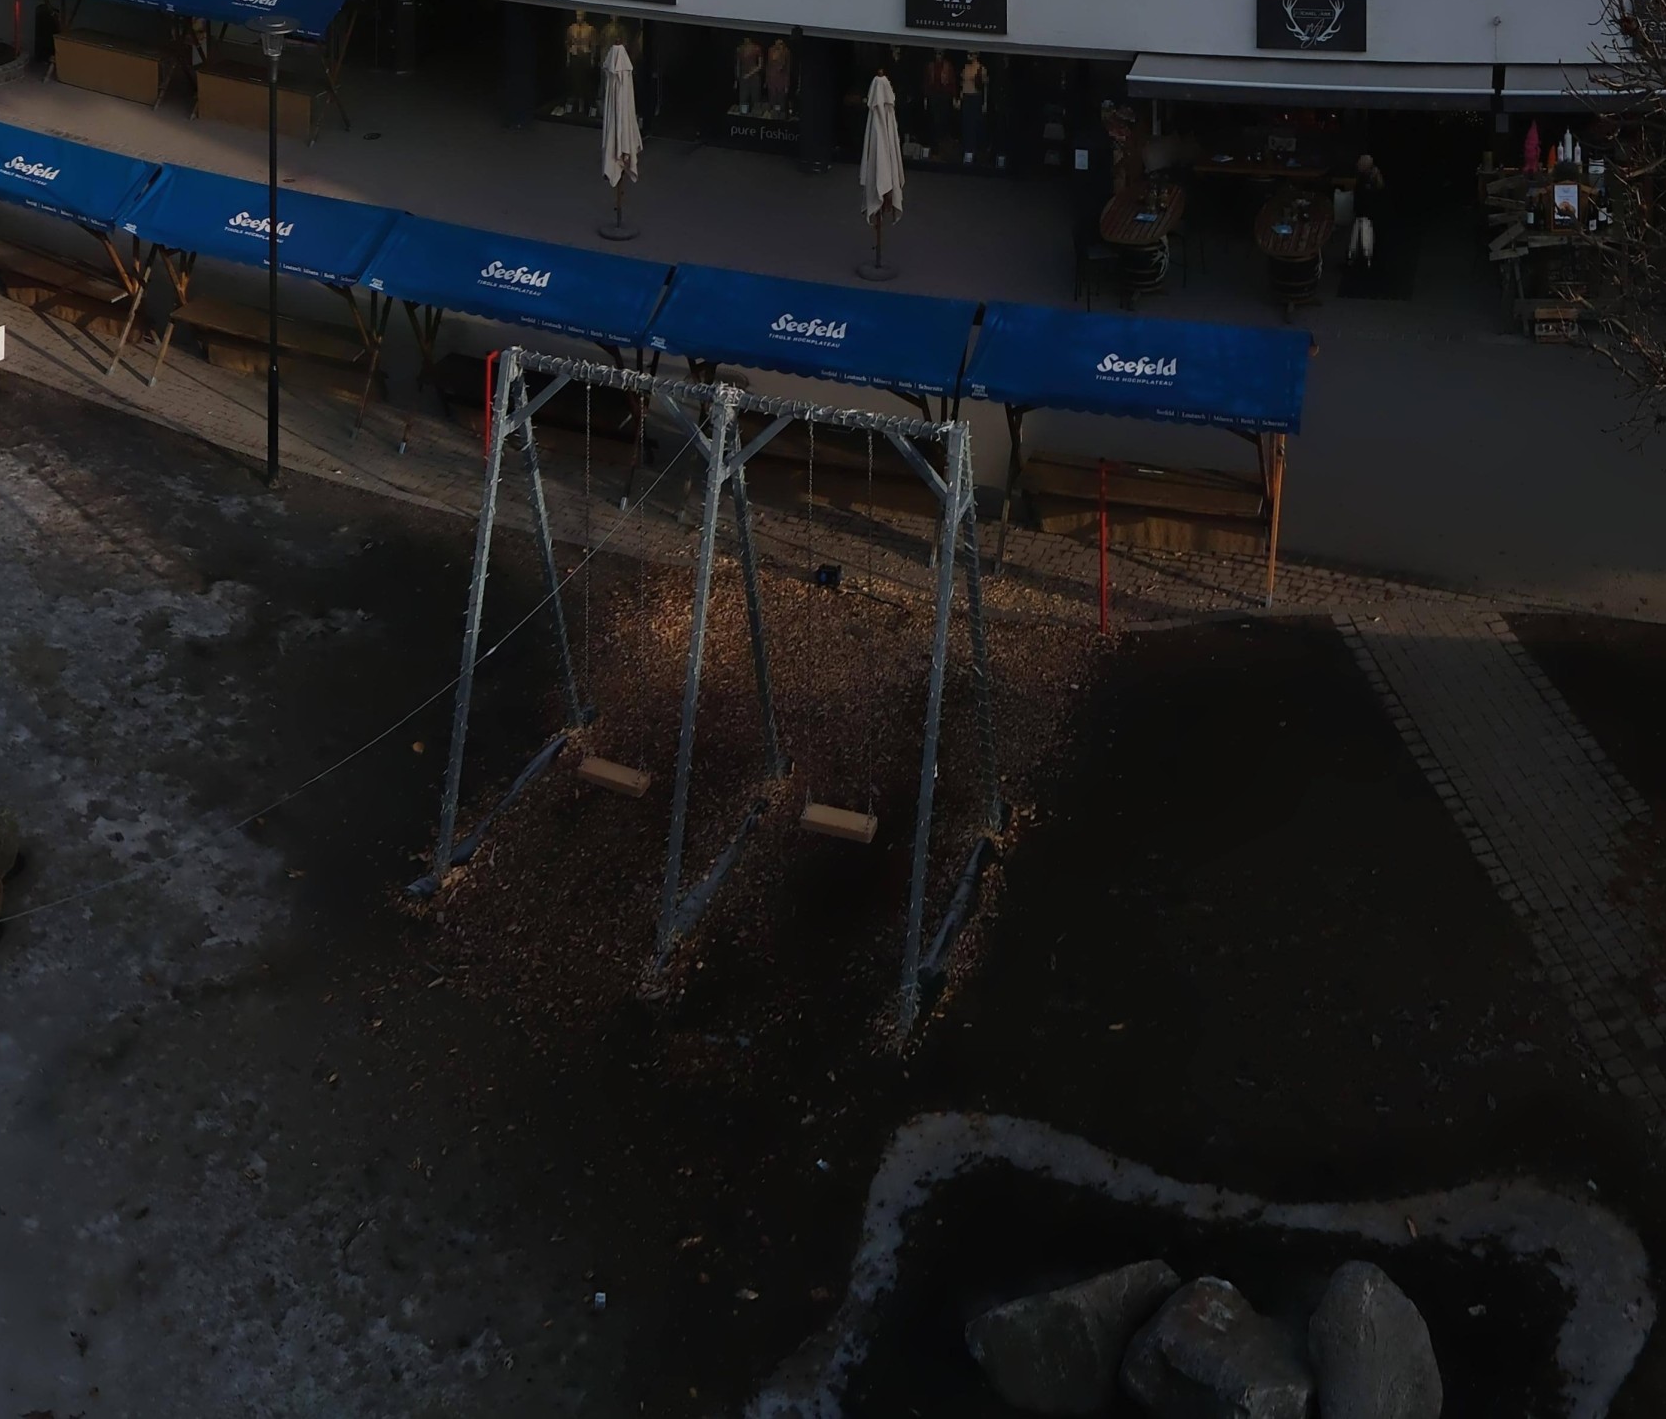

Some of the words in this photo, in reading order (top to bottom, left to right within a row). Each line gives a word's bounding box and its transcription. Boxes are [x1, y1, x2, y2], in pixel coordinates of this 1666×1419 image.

[229, 212, 295, 237] Seefld
[481, 261, 551, 288] Seefeld
[771, 313, 847, 339] Seefeld
[1097, 353, 1177, 376] Seefeld
